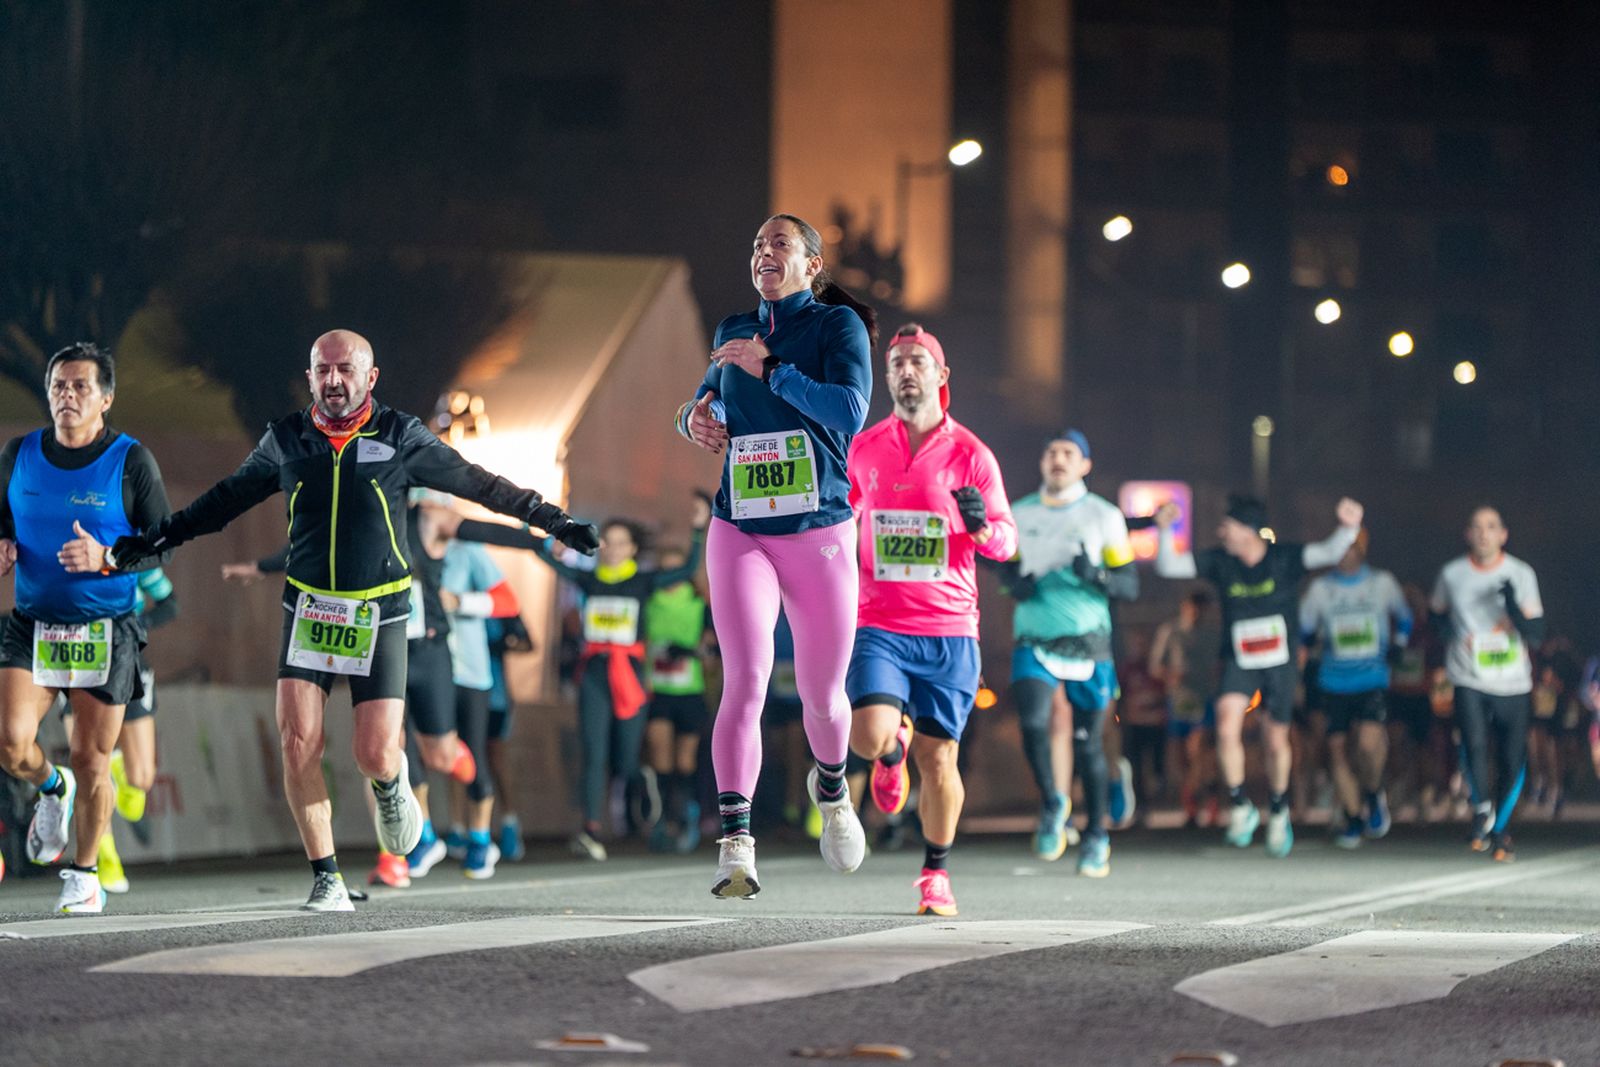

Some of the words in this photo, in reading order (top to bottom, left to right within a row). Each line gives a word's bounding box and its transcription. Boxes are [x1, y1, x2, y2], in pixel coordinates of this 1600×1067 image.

[768, 441, 778, 450] DE
[738, 454, 751, 464] SAN
[746, 461, 795, 489] 7887
[882, 536, 937, 558] 12267
[303, 609, 320, 620] SAN
[313, 602, 337, 613] NOCHE
[338, 606, 348, 615] DE
[311, 622, 358, 649] 9176
[50, 642, 95, 663] 7668
